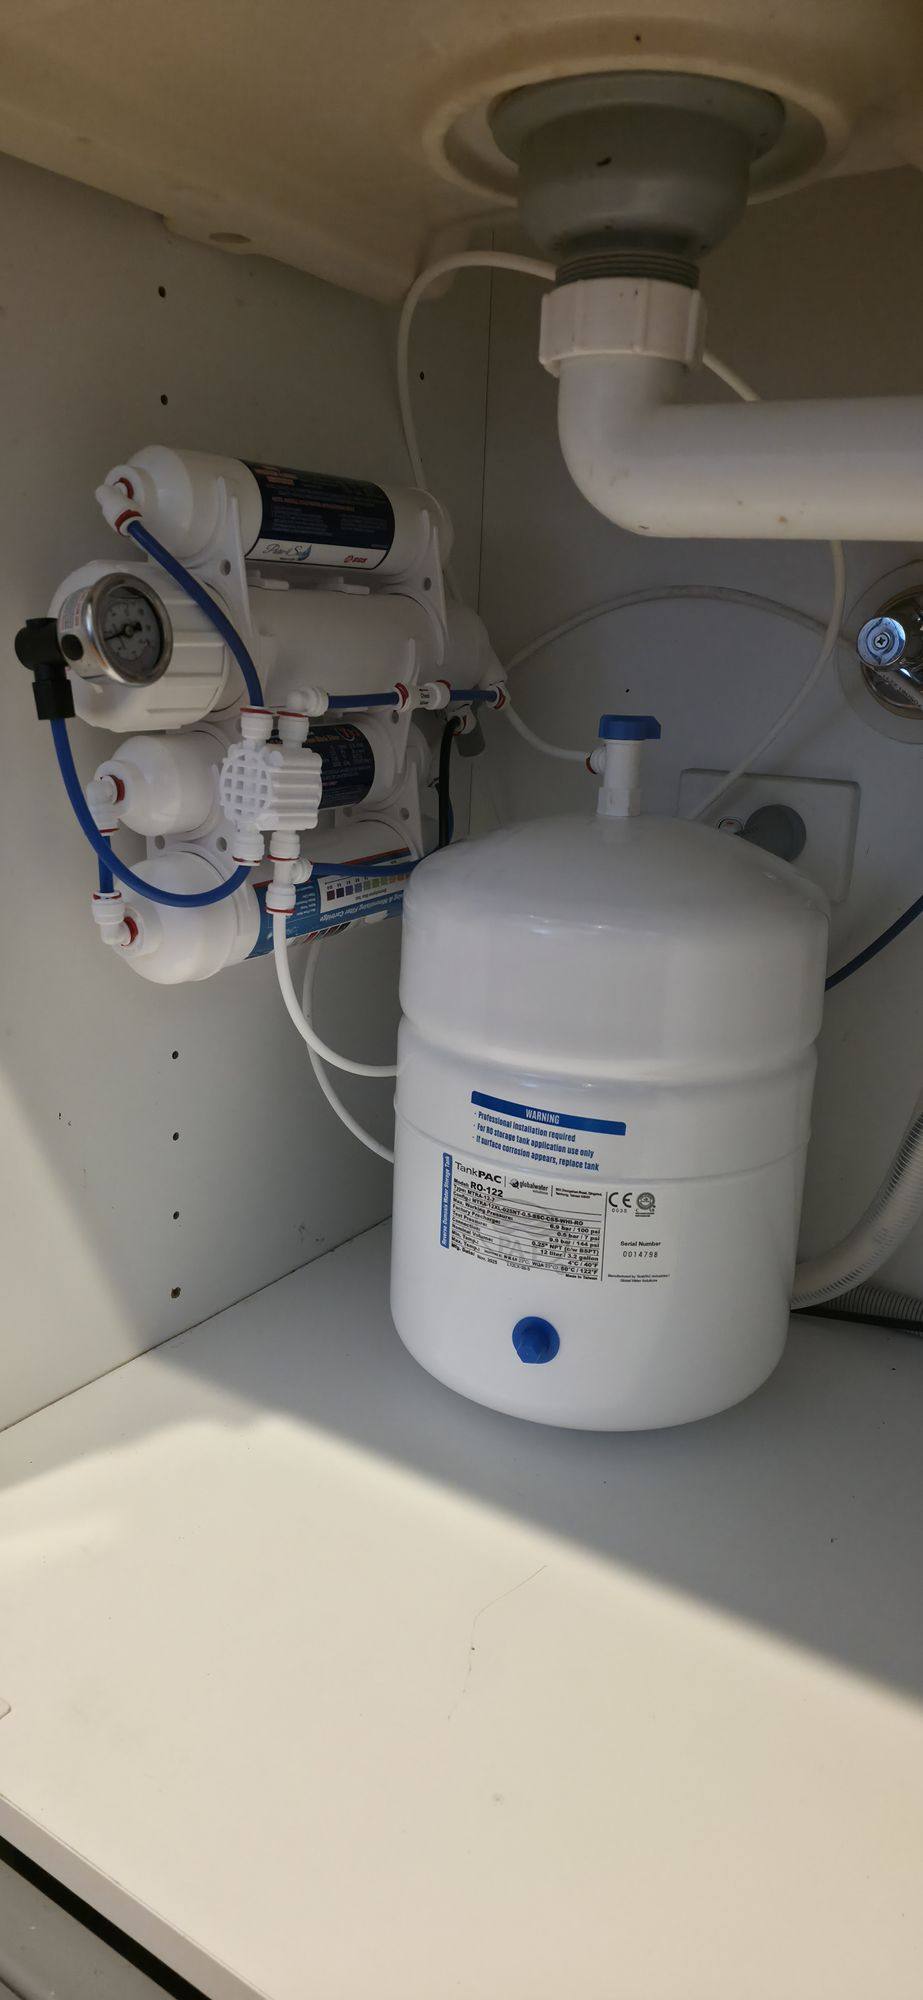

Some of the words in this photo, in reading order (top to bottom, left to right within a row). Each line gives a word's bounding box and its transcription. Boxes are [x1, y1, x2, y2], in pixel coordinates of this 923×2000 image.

[478, 1111, 512, 1129] Professional
[512, 1121, 548, 1137] installation
[548, 1131, 576, 1142] required
[525, 1109, 560, 1125] WARNING
[477, 1122, 486, 1132] For
[486, 1126, 494, 1135] RO
[494, 1129, 516, 1142] storage
[516, 1135, 530, 1146] tank
[530, 1139, 566, 1153] application
[567, 1147, 579, 1156] use
[579, 1149, 594, 1159] only
[476, 1135, 481, 1143] If
[481, 1137, 502, 1150] surface
[502, 1144, 530, 1158] corrosion
[530, 1152, 558, 1165] appears,
[559, 1158, 583, 1169] replace
[584, 1161, 600, 1171] tank
[454, 1161, 502, 1184] TankPAC
[470, 1181, 504, 1198] RO-122
[622, 1250, 658, 1258] 0014798
